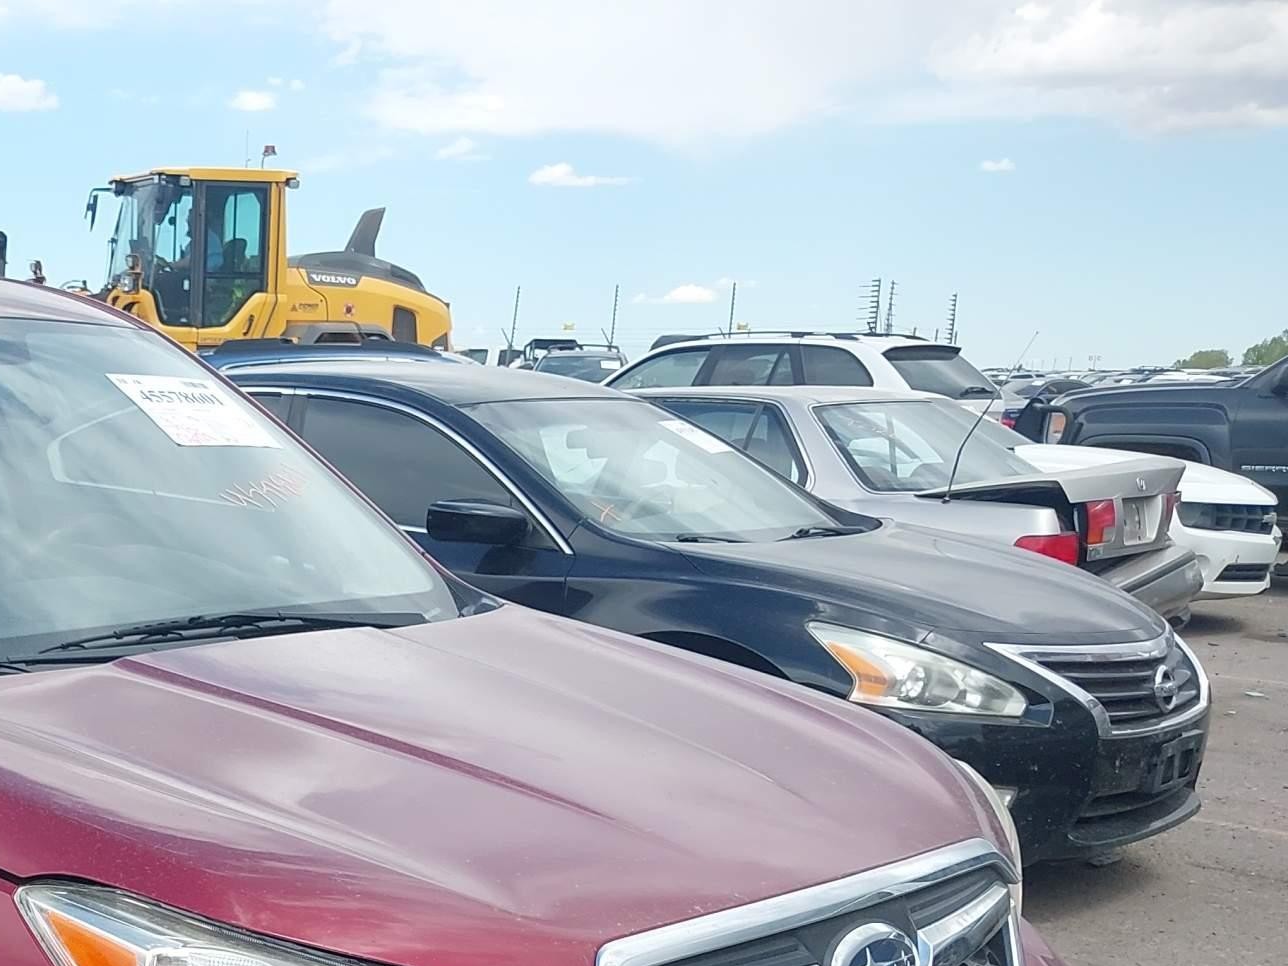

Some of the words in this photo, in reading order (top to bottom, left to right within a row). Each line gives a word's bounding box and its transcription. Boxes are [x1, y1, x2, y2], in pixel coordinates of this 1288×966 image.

[310, 273, 357, 285] VOLVO
[139, 389, 224, 407] 45578601
[1241, 464, 1288, 472] SIERR
